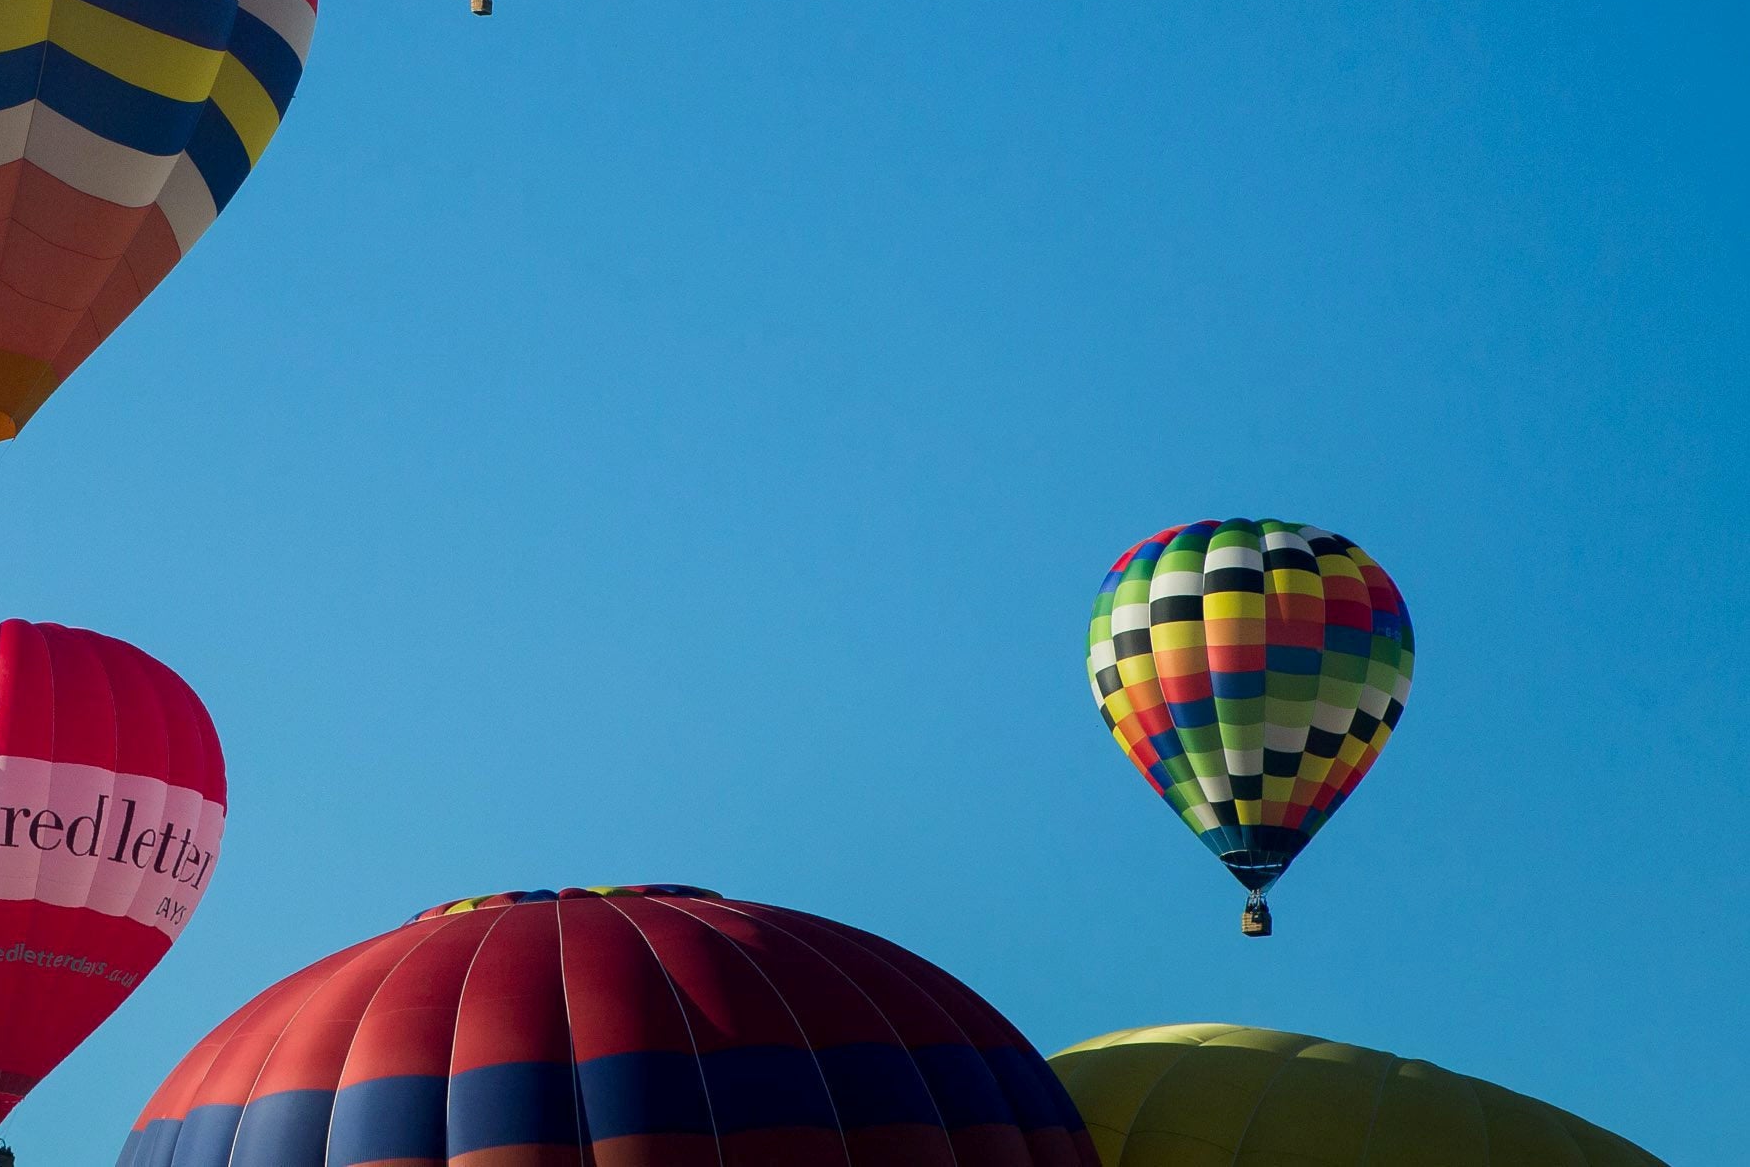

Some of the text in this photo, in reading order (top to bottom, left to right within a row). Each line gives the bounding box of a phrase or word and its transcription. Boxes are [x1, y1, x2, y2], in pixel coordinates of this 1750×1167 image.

[0, 794, 213, 890] red letter
[156, 896, 188, 925] DAYS
